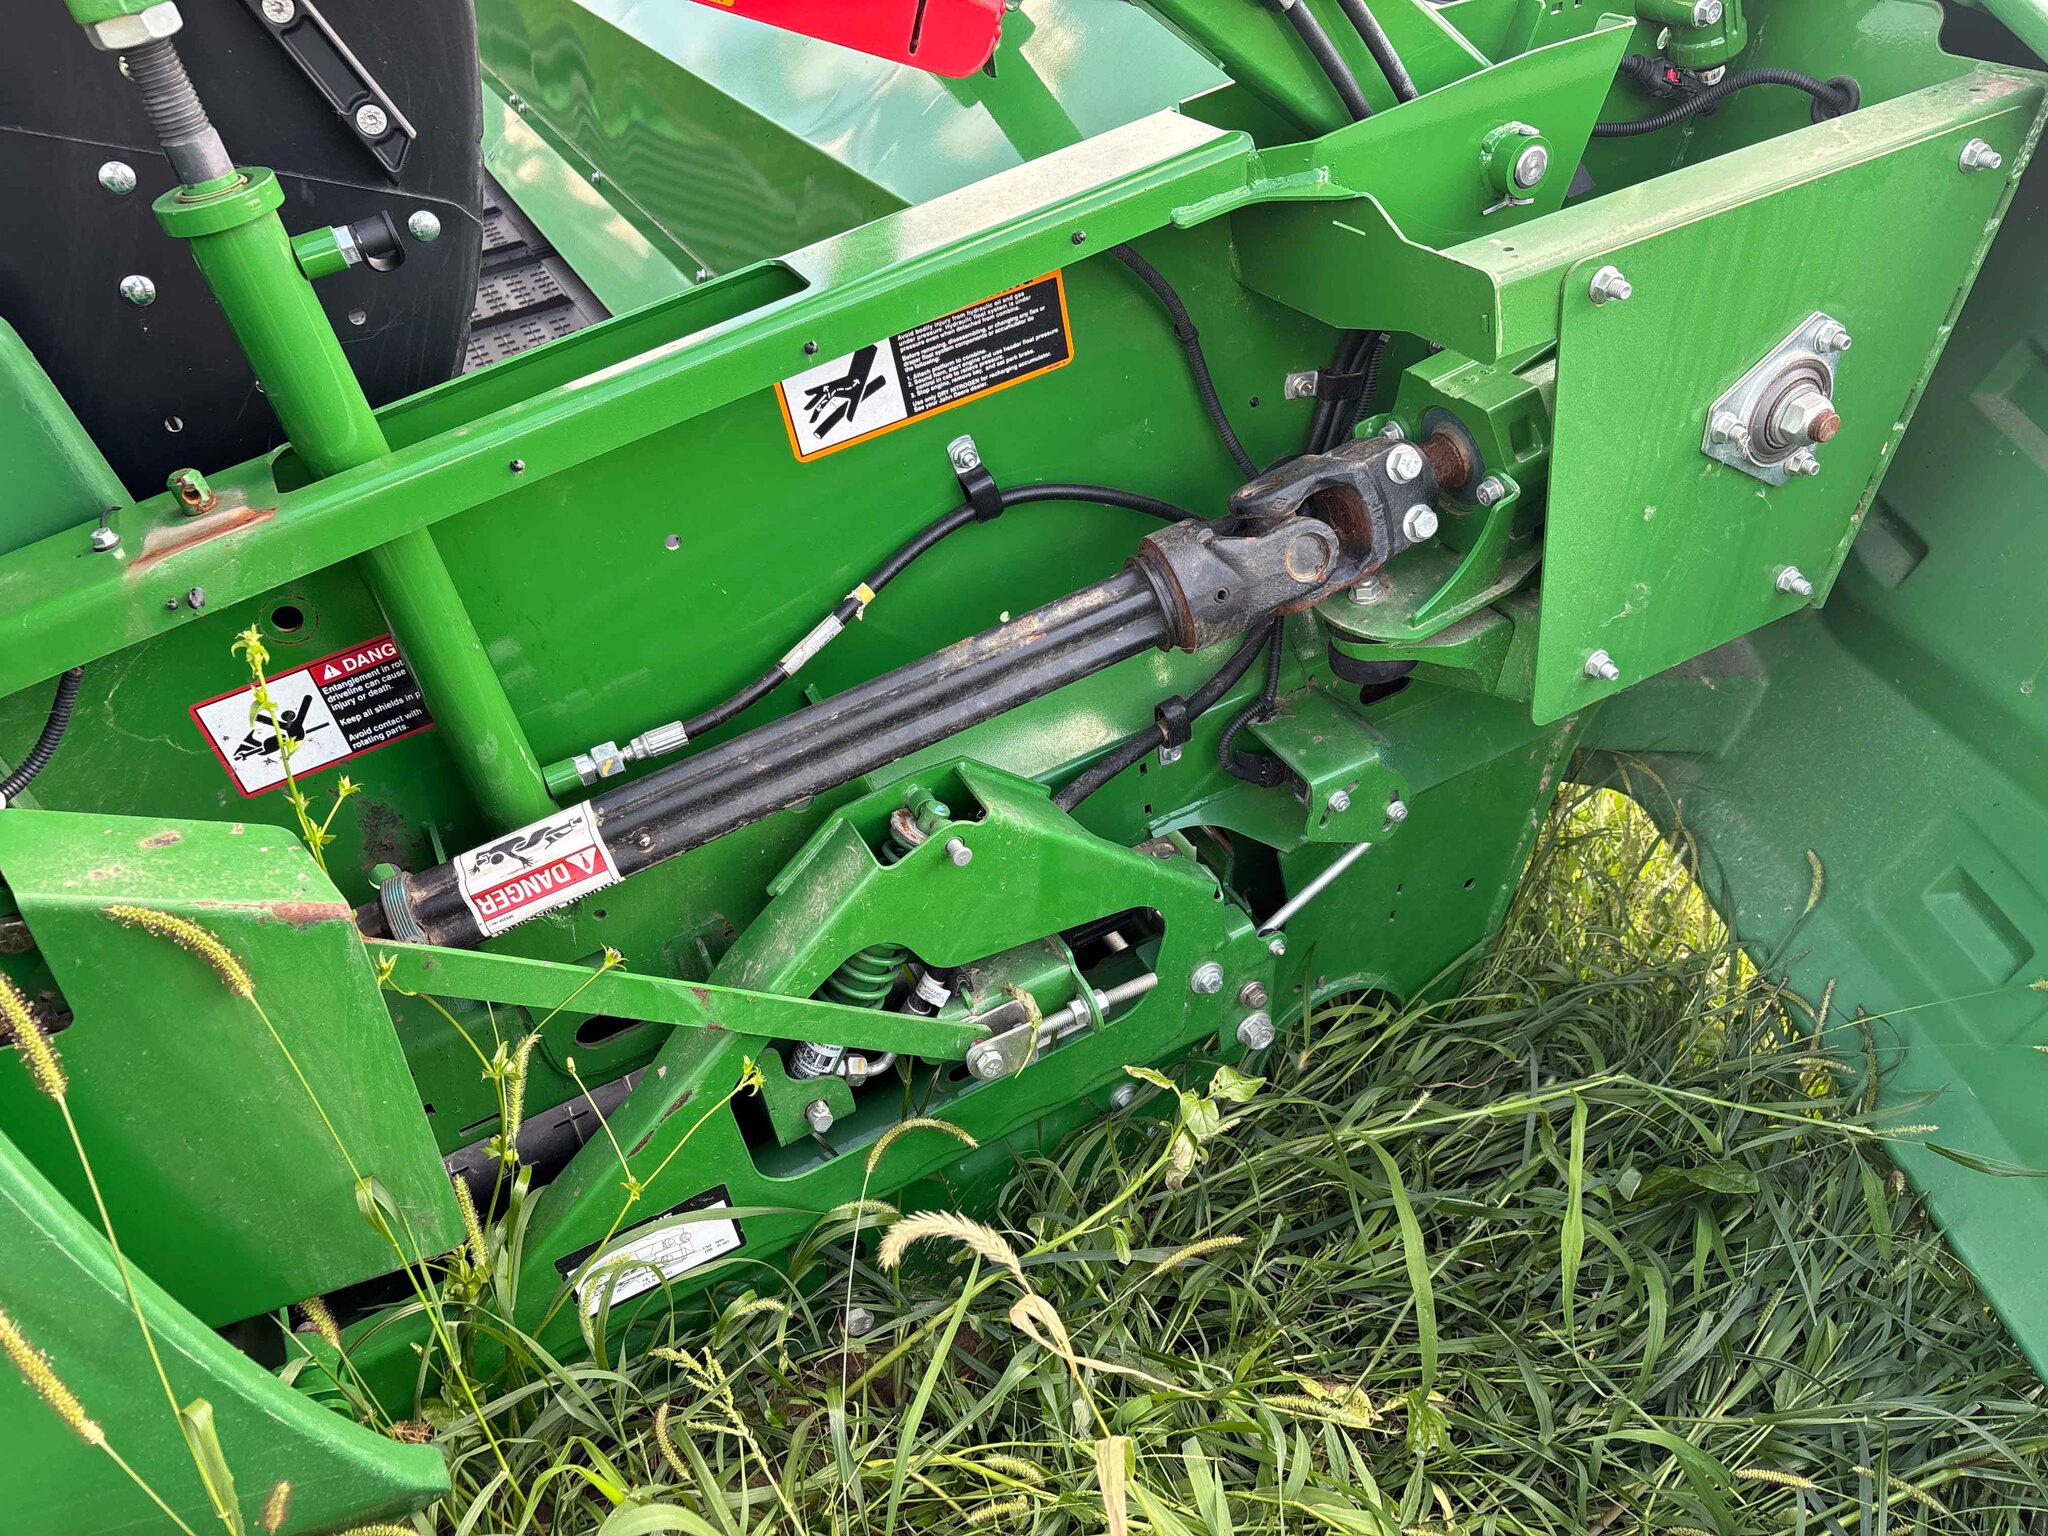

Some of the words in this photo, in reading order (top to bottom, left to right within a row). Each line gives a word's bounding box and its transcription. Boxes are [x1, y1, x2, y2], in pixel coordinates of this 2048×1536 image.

[898, 330, 914, 341] Avoid
[915, 325, 933, 335] bodily
[934, 318, 951, 328] injury
[952, 313, 966, 321] from
[966, 303, 993, 318] hydraulic
[1003, 295, 1014, 303] and
[1014, 292, 1025, 300] gas
[899, 337, 916, 347] under
[945, 317, 972, 330] Hydraulic
[973, 311, 987, 320] float
[987, 304, 1008, 315] system
[1015, 295, 1031, 305] under
[900, 340, 925, 354] pressure
[926, 335, 940, 344] even
[940, 329, 956, 338] when
[956, 319, 982, 332] detached
[982, 314, 995, 323] from
[996, 306, 1021, 318] combine.
[902, 351, 921, 362] Before
[994, 316, 1019, 328] changing
[903, 357, 922, 369] draper
[922, 352, 935, 361] float
[935, 345, 955, 356] system
[955, 332, 988, 349] components
[995, 319, 1027, 334] accumulator
[913, 369, 931, 380] Attach
[932, 361, 955, 374] platform
[962, 349, 987, 362] combine.
[914, 374, 933, 385] Sound
[948, 364, 962, 373] start
[962, 357, 981, 368] engine
[981, 352, 992, 361] and
[1003, 342, 1022, 352] header
[1022, 336, 1035, 345] float
[1035, 328, 1059, 342] pressure
[914, 355, 941, 369] following:
[917, 388, 930, 396] Stop
[931, 381, 951, 391] engine,
[951, 373, 972, 384] remove
[985, 362, 996, 371] and
[996, 359, 1006, 367] set
[1006, 355, 1018, 364] park
[1018, 349, 1035, 359] brake.
[912, 399, 924, 407] Use
[924, 395, 937, 403] only
[937, 389, 949, 398] DRY
[950, 378, 980, 393] NITROGEN
[989, 364, 1018, 379] recharging
[1018, 352, 1052, 368] accumulator.
[916, 379, 936, 391] control
[942, 373, 953, 381] cab
[960, 364, 979, 374] relieve
[914, 405, 925, 413] See
[925, 400, 938, 410] your
[939, 395, 953, 404] John
[953, 388, 970, 398] Deere
[970, 382, 988, 392] dealer.
[342, 643, 397, 672] DANG
[322, 668, 381, 696] Entanglement
[391, 660, 404, 669] rot
[327, 686, 364, 703] driveline
[365, 679, 381, 689] can
[382, 670, 406, 683] cause
[331, 698, 356, 711] injury
[368, 684, 394, 697] death.
[339, 714, 362, 727] Keep
[363, 708, 374, 718] all
[375, 698, 404, 713] shields
[404, 694, 414, 702] in
[349, 727, 373, 742] Avoid
[373, 716, 404, 732] contact
[405, 709, 422, 719] with
[353, 733, 385, 749] rotating
[386, 725, 409, 738] parts.
[477, 862, 571, 915] DANGER
